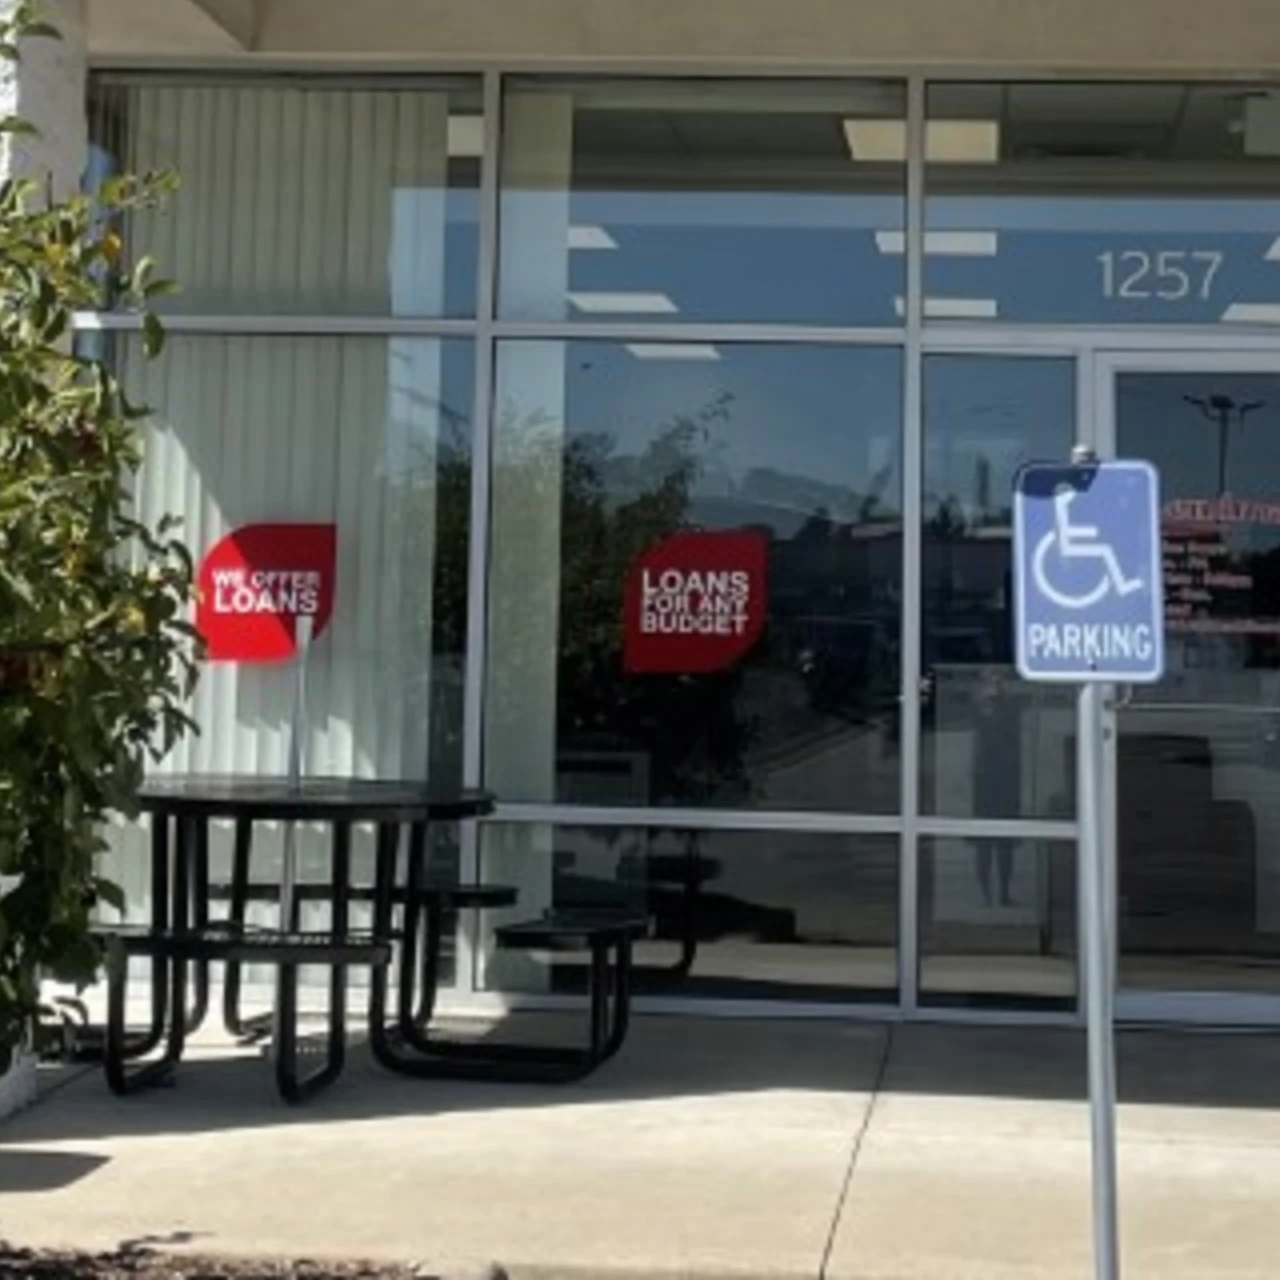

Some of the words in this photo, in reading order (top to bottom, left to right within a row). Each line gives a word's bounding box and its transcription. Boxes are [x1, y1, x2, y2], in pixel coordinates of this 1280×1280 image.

[1096, 251, 1222, 299] 1257
[642, 569, 750, 597] LOANS
[214, 587, 318, 613] LOANS
[642, 595, 689, 614] FOR
[698, 596, 748, 615] ANY
[641, 613, 749, 635] BUDGET
[1027, 622, 1152, 661] PARKING
